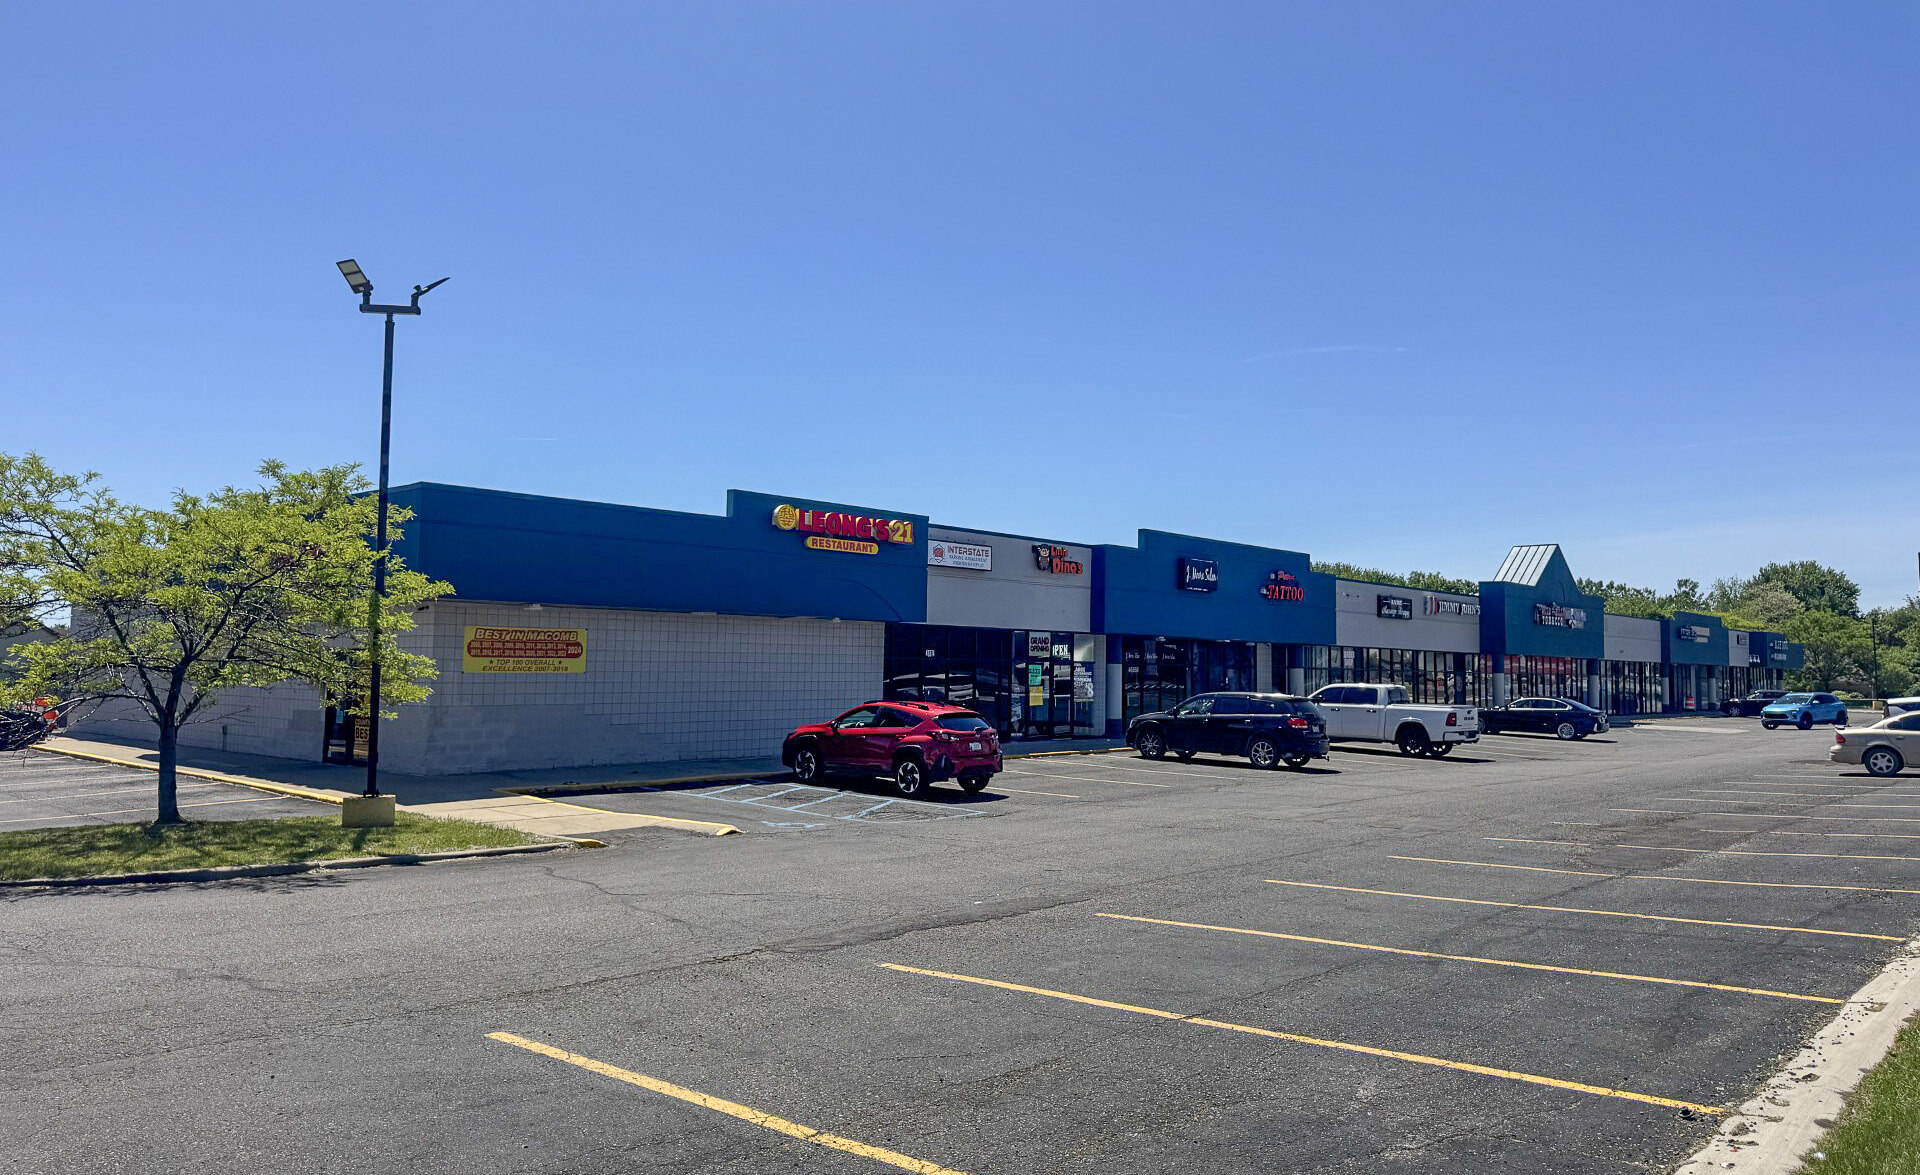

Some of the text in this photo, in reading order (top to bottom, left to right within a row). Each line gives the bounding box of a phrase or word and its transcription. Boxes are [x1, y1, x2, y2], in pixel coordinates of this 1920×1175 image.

[798, 508, 891, 541] LEONG'S
[890, 520, 914, 545] 21
[811, 537, 874, 553] RESTAURANT
[947, 545, 990, 557] INTERSTATE
[1268, 585, 1304, 601] TATTOO
[1439, 601, 1480, 615] JIMMY JOHN'S
[475, 628, 578, 641] BEST IN MACOMB
[1030, 636, 1049, 645] GRAND
[567, 645, 582, 654] 2024
[1030, 645, 1049, 653] OPENING
[356, 728, 369, 739] BES
